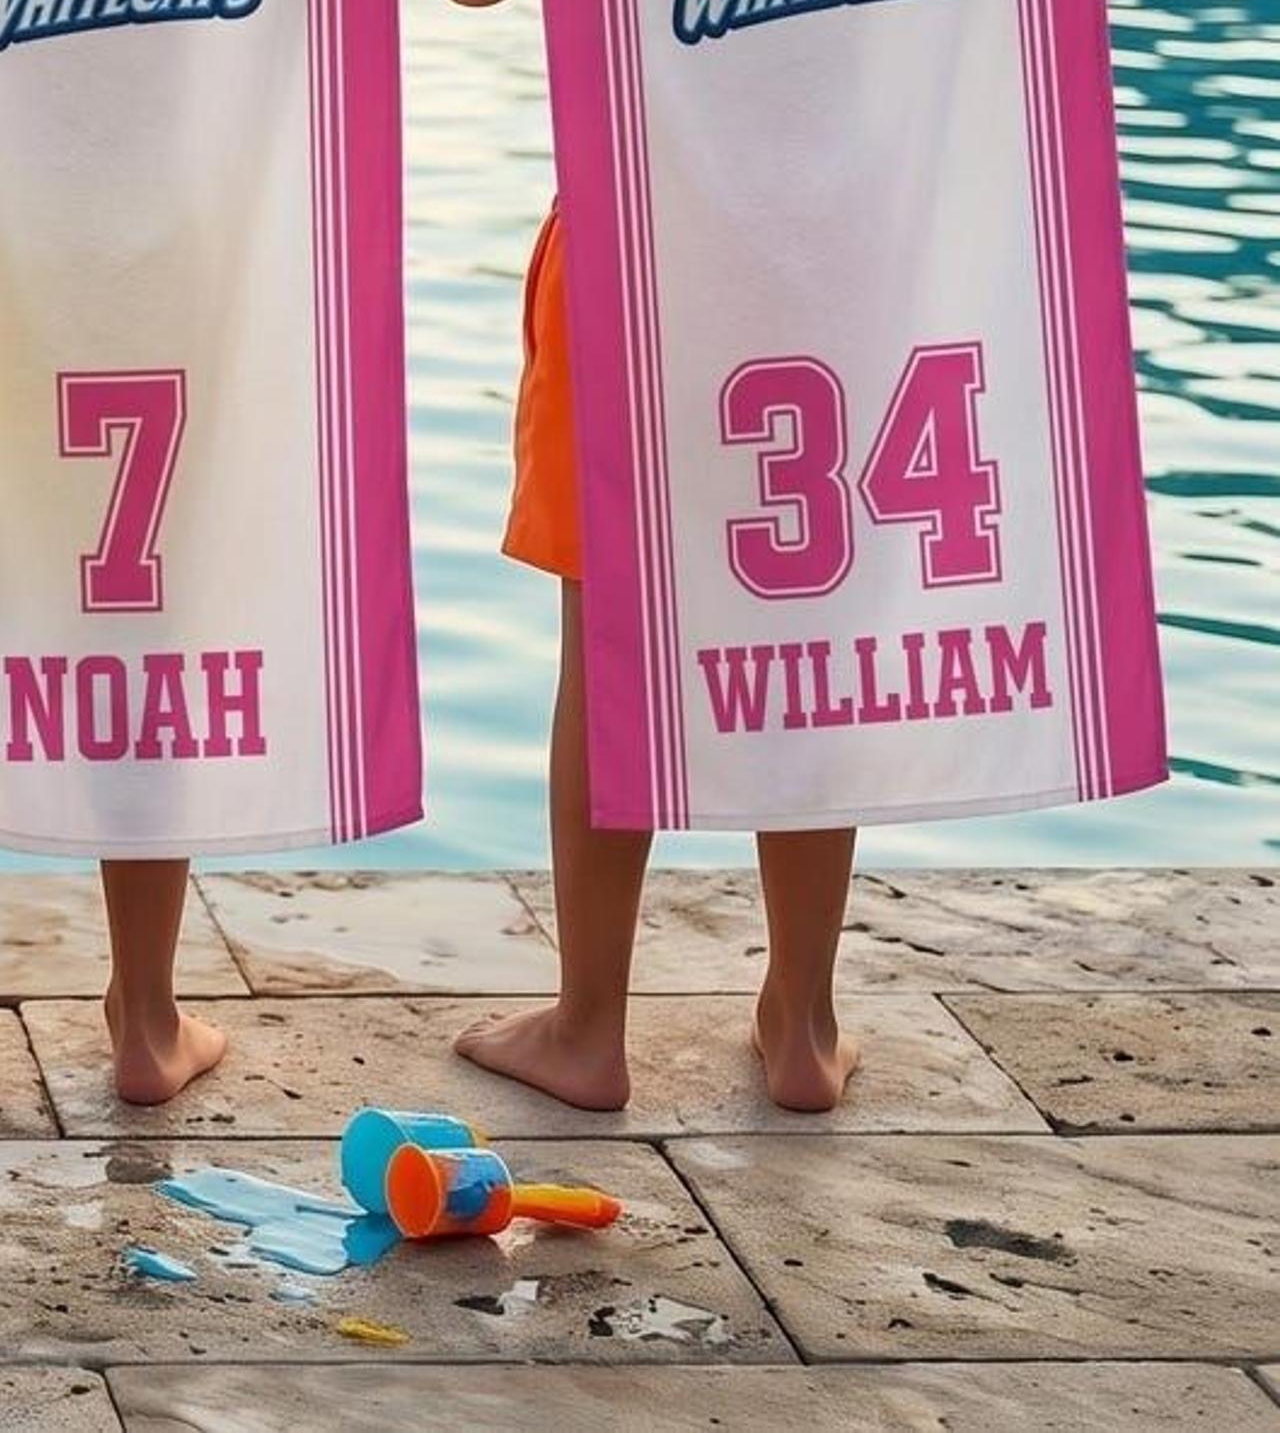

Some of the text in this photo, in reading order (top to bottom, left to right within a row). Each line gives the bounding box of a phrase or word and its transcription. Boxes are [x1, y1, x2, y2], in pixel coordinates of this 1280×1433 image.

[57, 370, 187, 613] 7
[718, 343, 1000, 601] 34
[4, 650, 266, 762] NOAH
[698, 622, 1052, 733] WILLIAM
